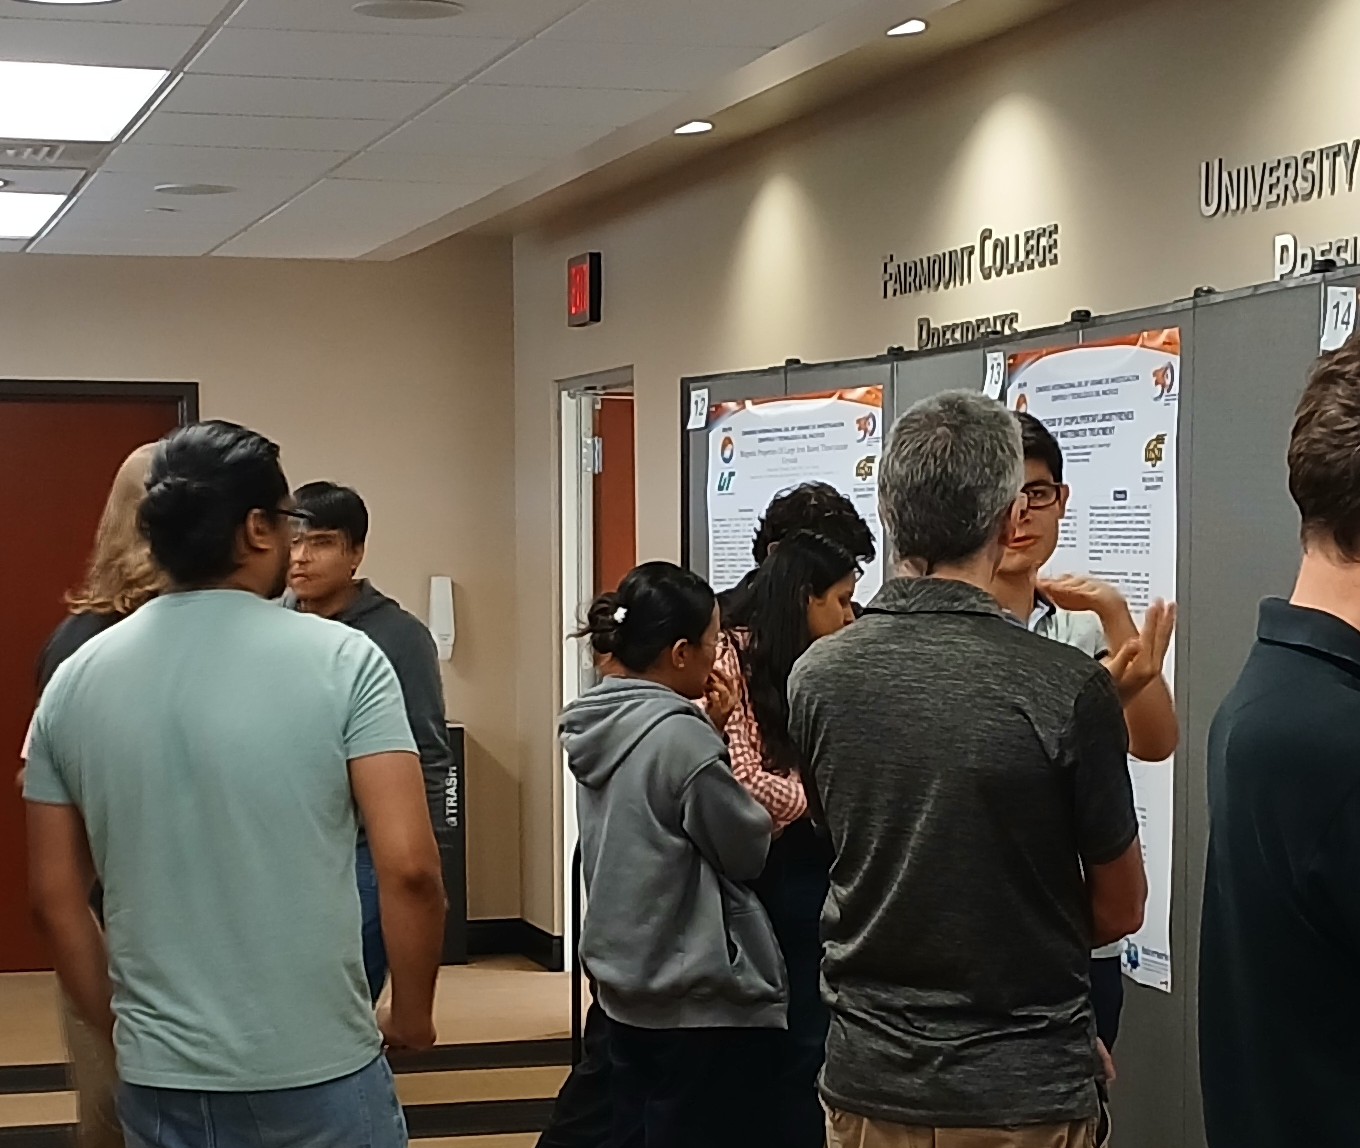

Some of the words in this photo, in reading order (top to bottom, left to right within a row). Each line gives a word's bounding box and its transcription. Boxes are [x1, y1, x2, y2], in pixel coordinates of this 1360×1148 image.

[1200, 139, 1360, 217] UNIVERSITY
[883, 245, 975, 298] FAIRMOUNT
[980, 223, 1059, 281] COLLEGE
[1332, 301, 1352, 331] 14
[990, 362, 1001, 385] 13
[693, 397, 706, 416] 12
[445, 766, 458, 816] TRASH
